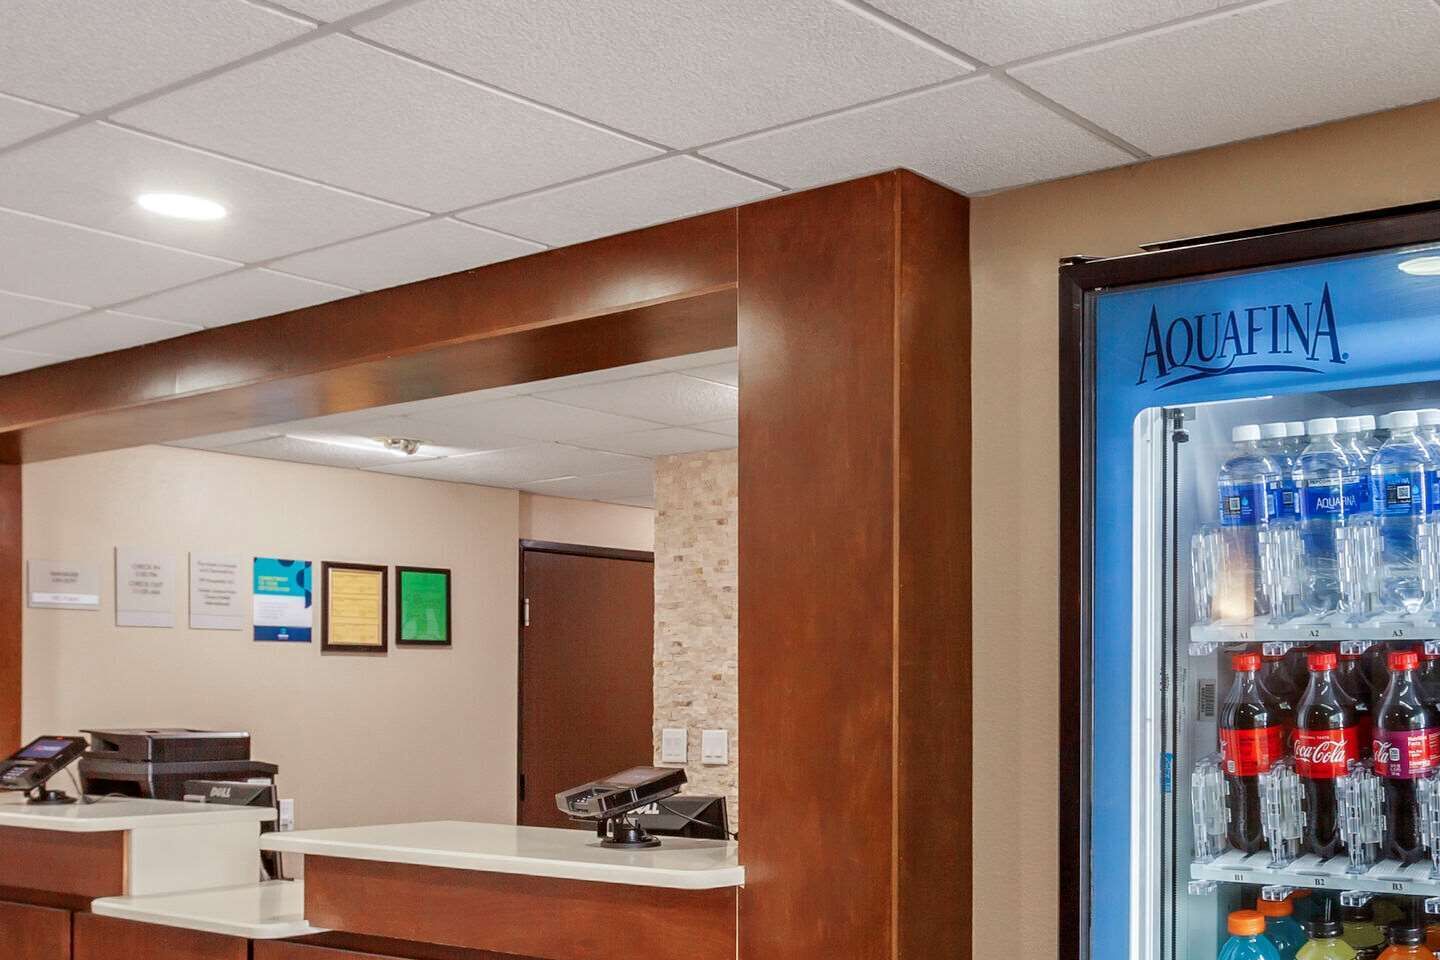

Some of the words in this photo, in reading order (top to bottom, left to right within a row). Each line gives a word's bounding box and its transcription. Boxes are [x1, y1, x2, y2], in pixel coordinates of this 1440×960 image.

[1136, 281, 1347, 386] AQUAFINA
[1310, 629, 1320, 638] A2
[627, 802, 660, 815] ELL
[1314, 878, 1326, 886] B2
